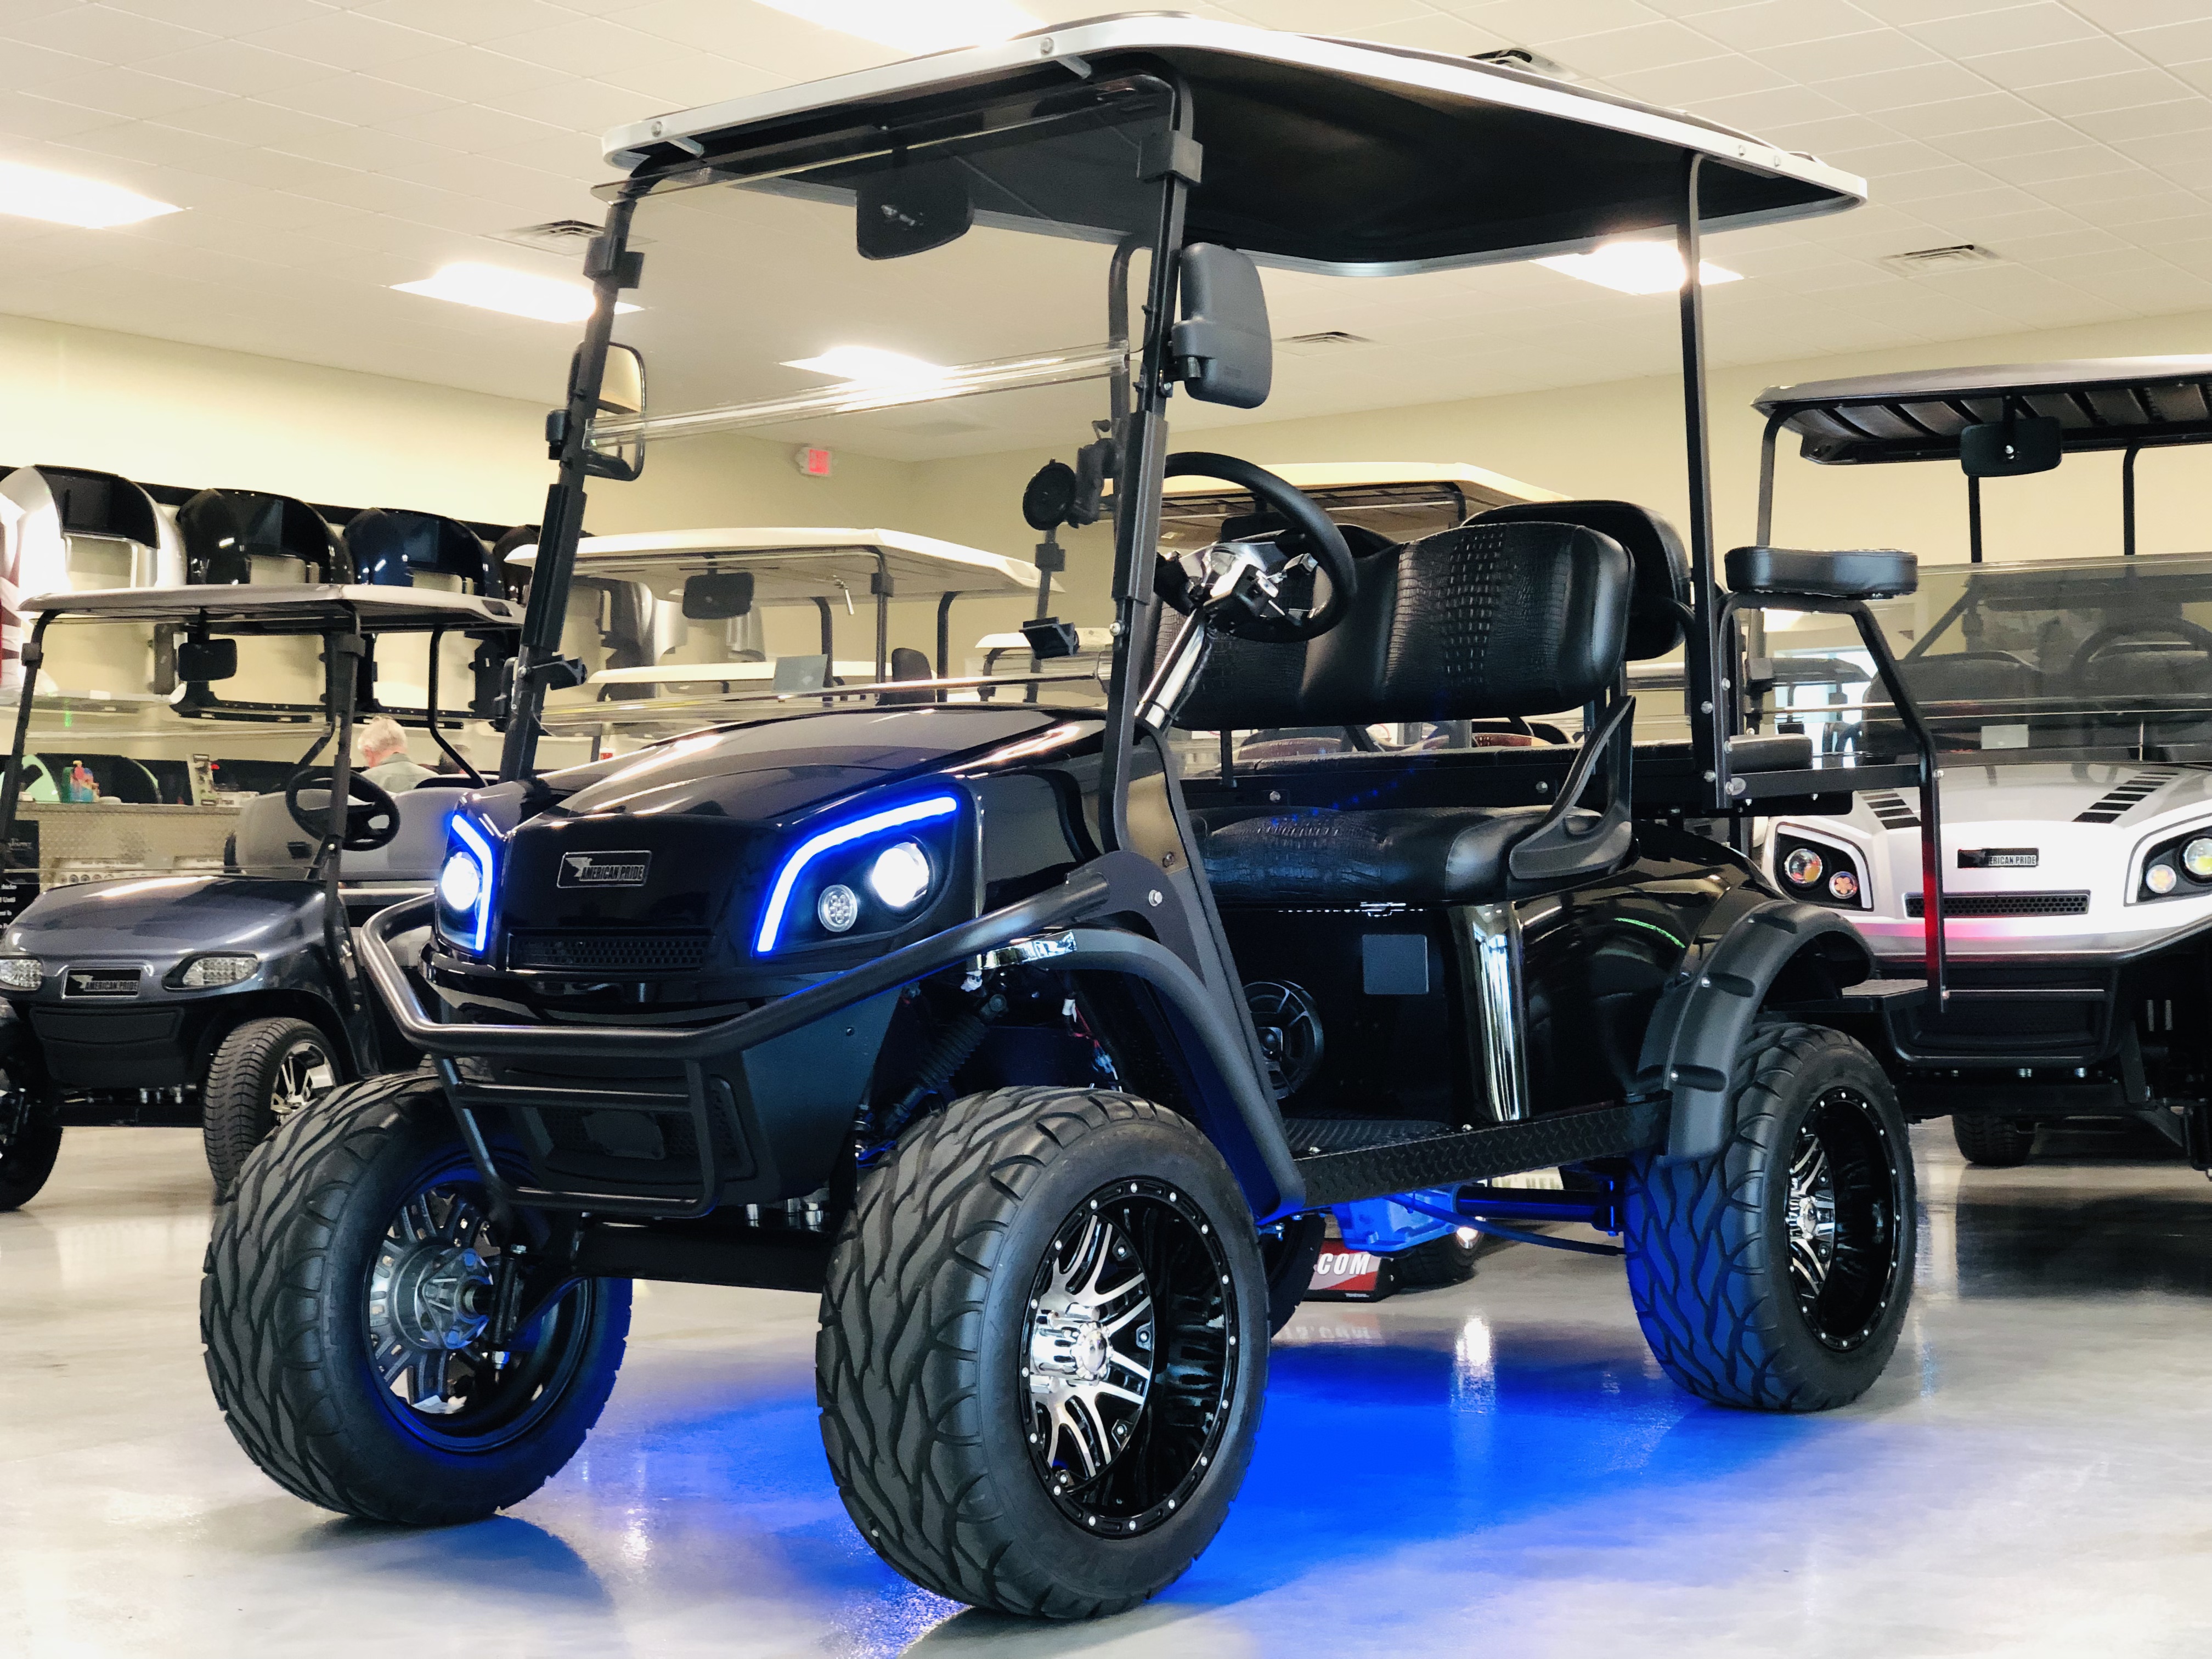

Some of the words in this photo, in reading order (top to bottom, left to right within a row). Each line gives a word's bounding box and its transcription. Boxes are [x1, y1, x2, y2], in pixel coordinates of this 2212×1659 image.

[2016, 856, 2036, 865] PRIDE
[580, 865, 619, 880] AMERICAN
[620, 865, 644, 879] PRIDE
[85, 981, 117, 990] AMERICAN
[119, 981, 138, 990] PRIDE
